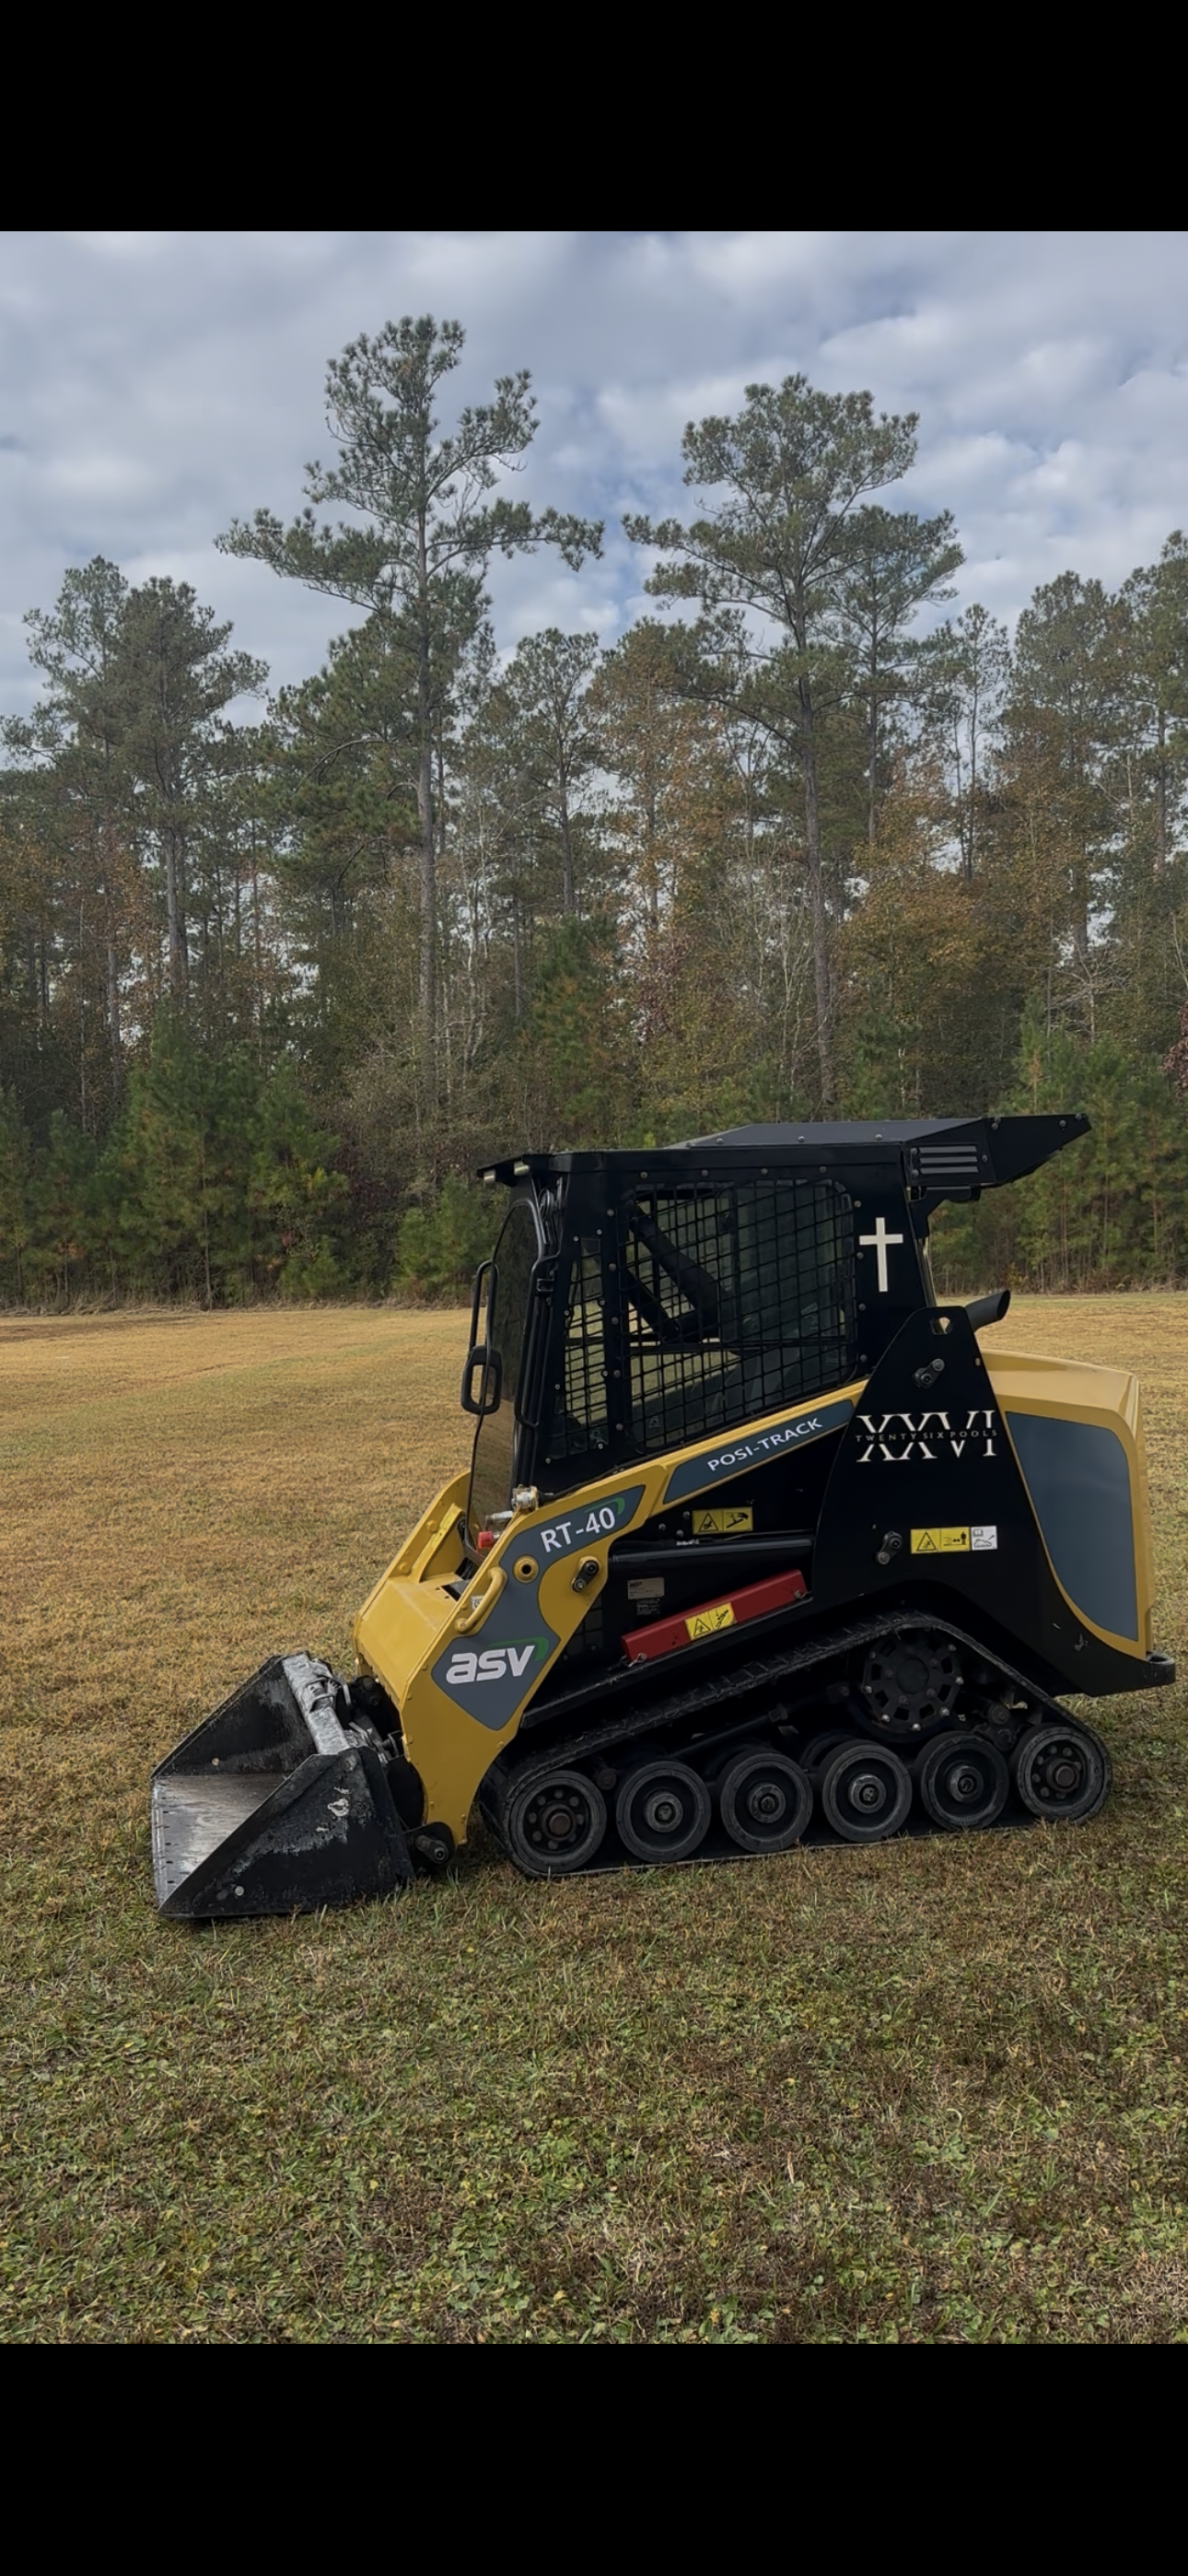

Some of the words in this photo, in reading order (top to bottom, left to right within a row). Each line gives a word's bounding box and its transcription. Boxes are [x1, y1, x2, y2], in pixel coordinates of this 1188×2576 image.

[707, 1418, 822, 1471] POSI-TRACK
[855, 1433, 917, 1443] TWENTY
[923, 1431, 945, 1439] SIX
[950, 1429, 997, 1438] POOLS
[856, 1410, 996, 1462] XXVI
[541, 1507, 616, 1553] RT-40
